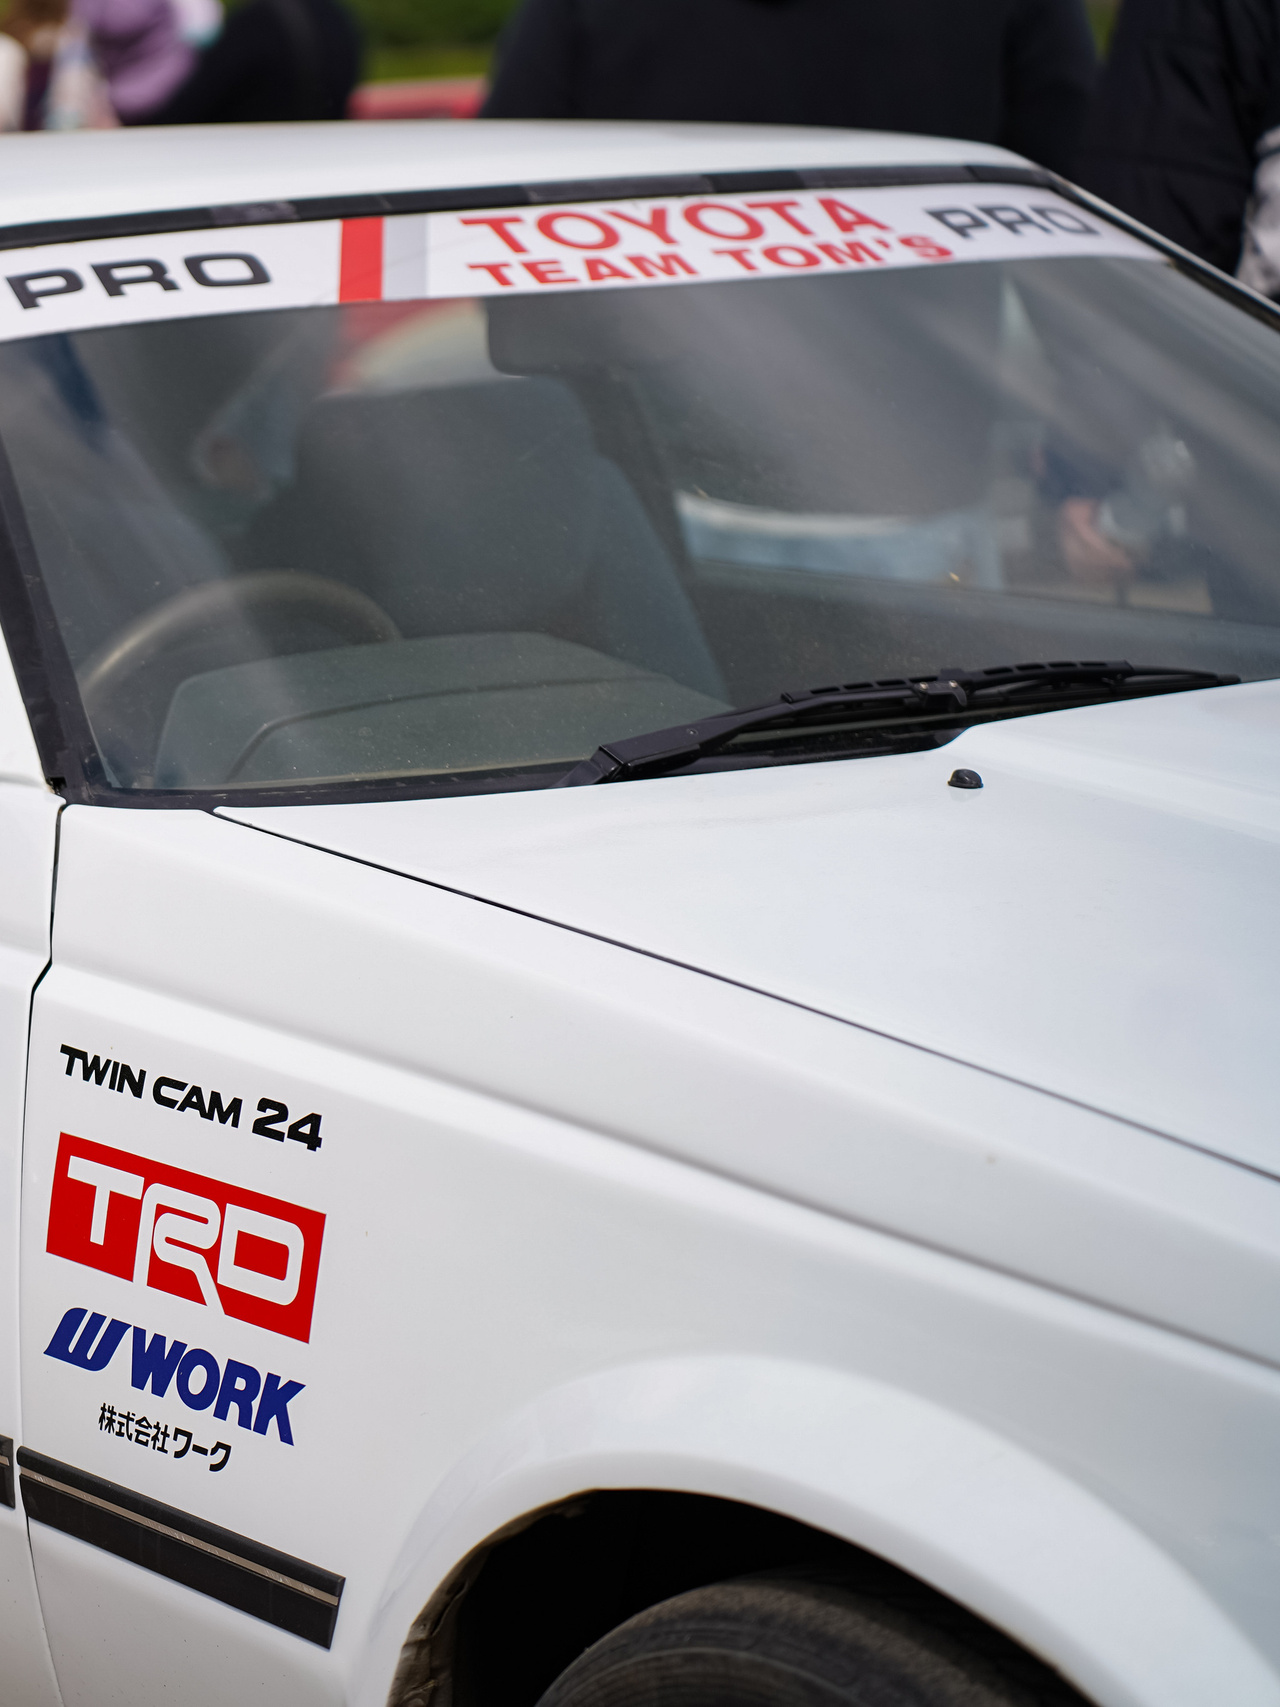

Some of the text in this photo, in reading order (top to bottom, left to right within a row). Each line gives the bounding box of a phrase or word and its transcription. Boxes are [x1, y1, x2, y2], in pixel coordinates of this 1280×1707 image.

[460, 196, 893, 254] TOYOTA
[924, 204, 1102, 240] PRO
[5, 253, 272, 309] PRO
[467, 234, 955, 287] TEAM TOM'S
[60, 1043, 323, 1152] TWIN CAM 24
[67, 1155, 305, 1312] TRD
[131, 1325, 307, 1446] WORK
[98, 1402, 233, 1473] 株式会社ワーク
